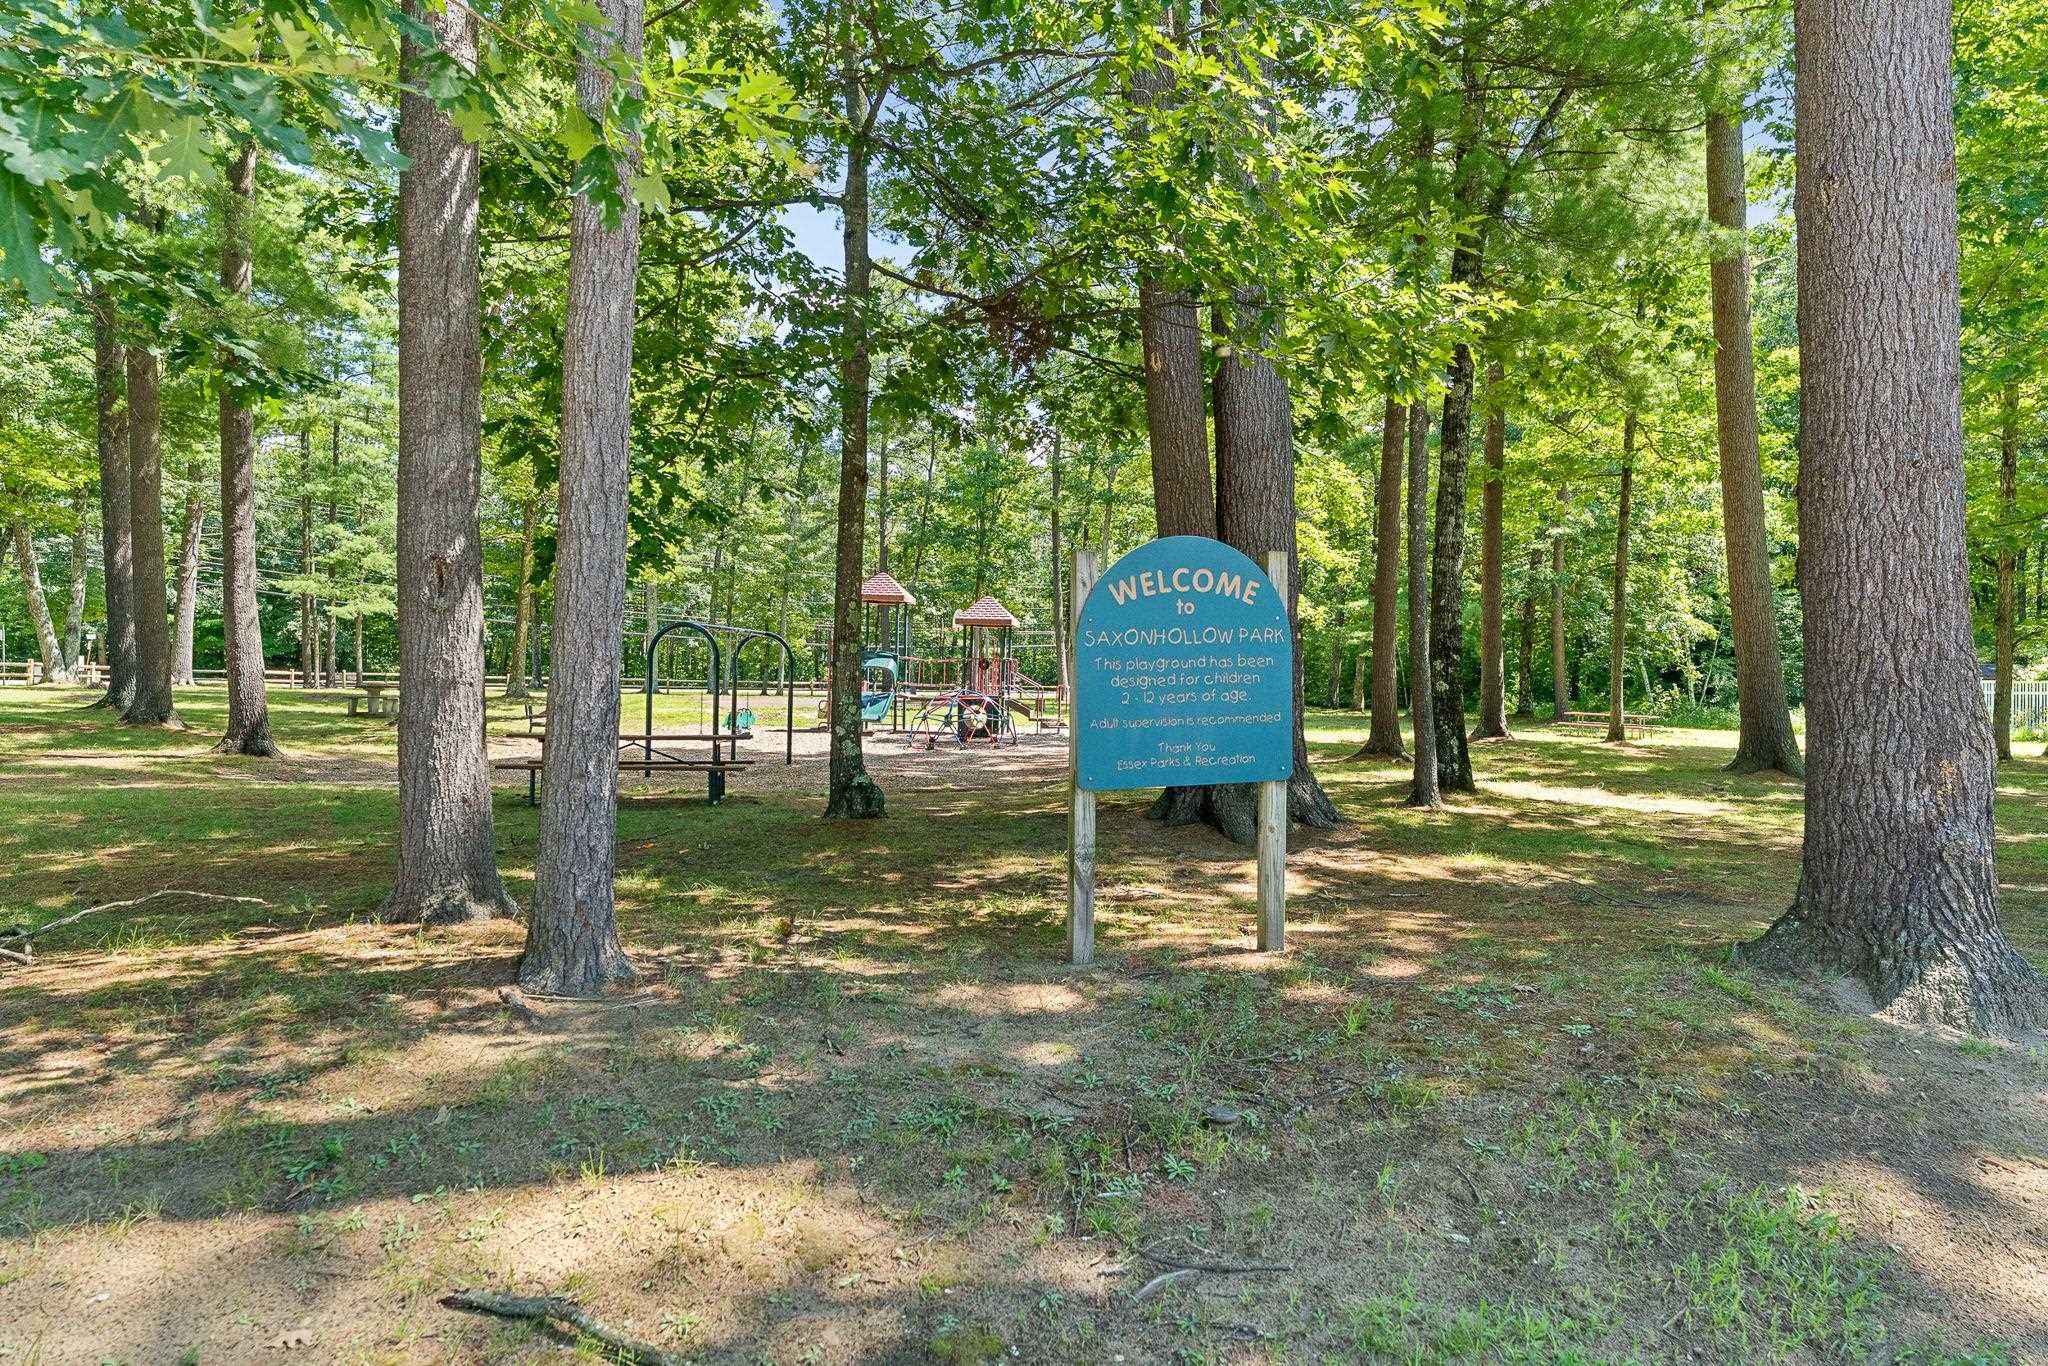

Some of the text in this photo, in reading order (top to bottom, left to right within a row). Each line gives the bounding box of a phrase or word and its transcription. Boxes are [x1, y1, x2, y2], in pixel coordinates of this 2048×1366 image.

[1108, 567, 1261, 605] WELCOME
[1176, 598, 1195, 615] to
[1239, 627, 1285, 644] PARK
[1094, 653, 1274, 673] This playground has been
[1110, 670, 1261, 689] designed for children
[1121, 692, 1130, 705] 2
[1143, 691, 1155, 703] 12
[1159, 692, 1197, 705] years
[1202, 689, 1216, 702] of
[1220, 691, 1252, 704] age.
[1089, 711, 1281, 730] Adult supervision is recommended
[1158, 741, 1216, 753] Thank You
[1117, 754, 1256, 771] Essex Parks & Recreation
